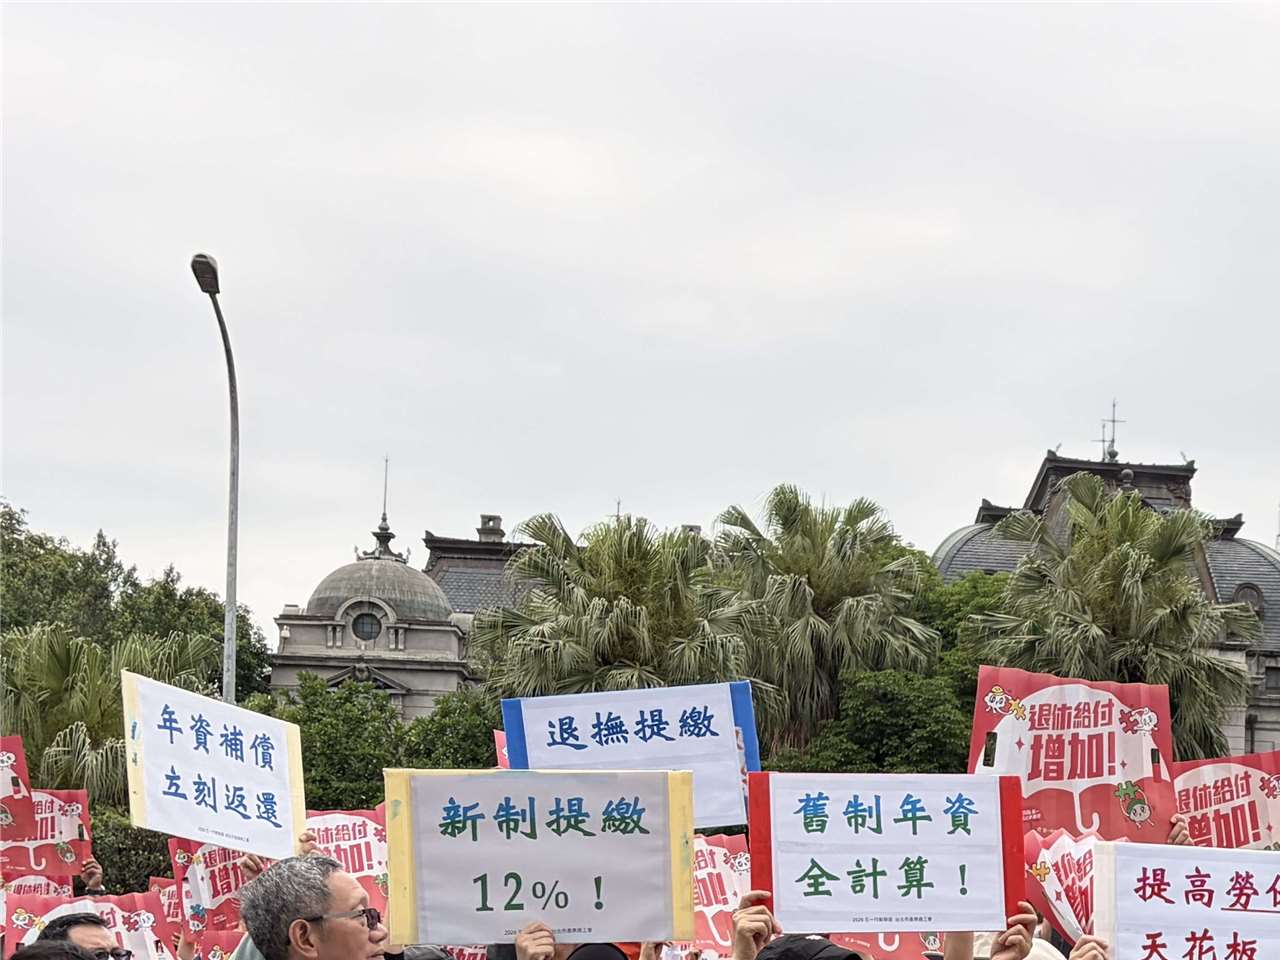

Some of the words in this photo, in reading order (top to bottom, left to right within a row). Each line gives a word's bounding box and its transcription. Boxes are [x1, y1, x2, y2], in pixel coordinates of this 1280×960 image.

[157, 703, 276, 772] 年資補償
[546, 705, 720, 750] 退撫提繳
[1028, 698, 1115, 732] 退休給付
[1027, 731, 1117, 781] 增加!
[162, 765, 283, 829] 立刻返還
[439, 796, 651, 842] 新制提繳
[793, 791, 979, 836] 舊制年資
[307, 819, 368, 845] 休給付
[795, 855, 969, 899] 全計算！
